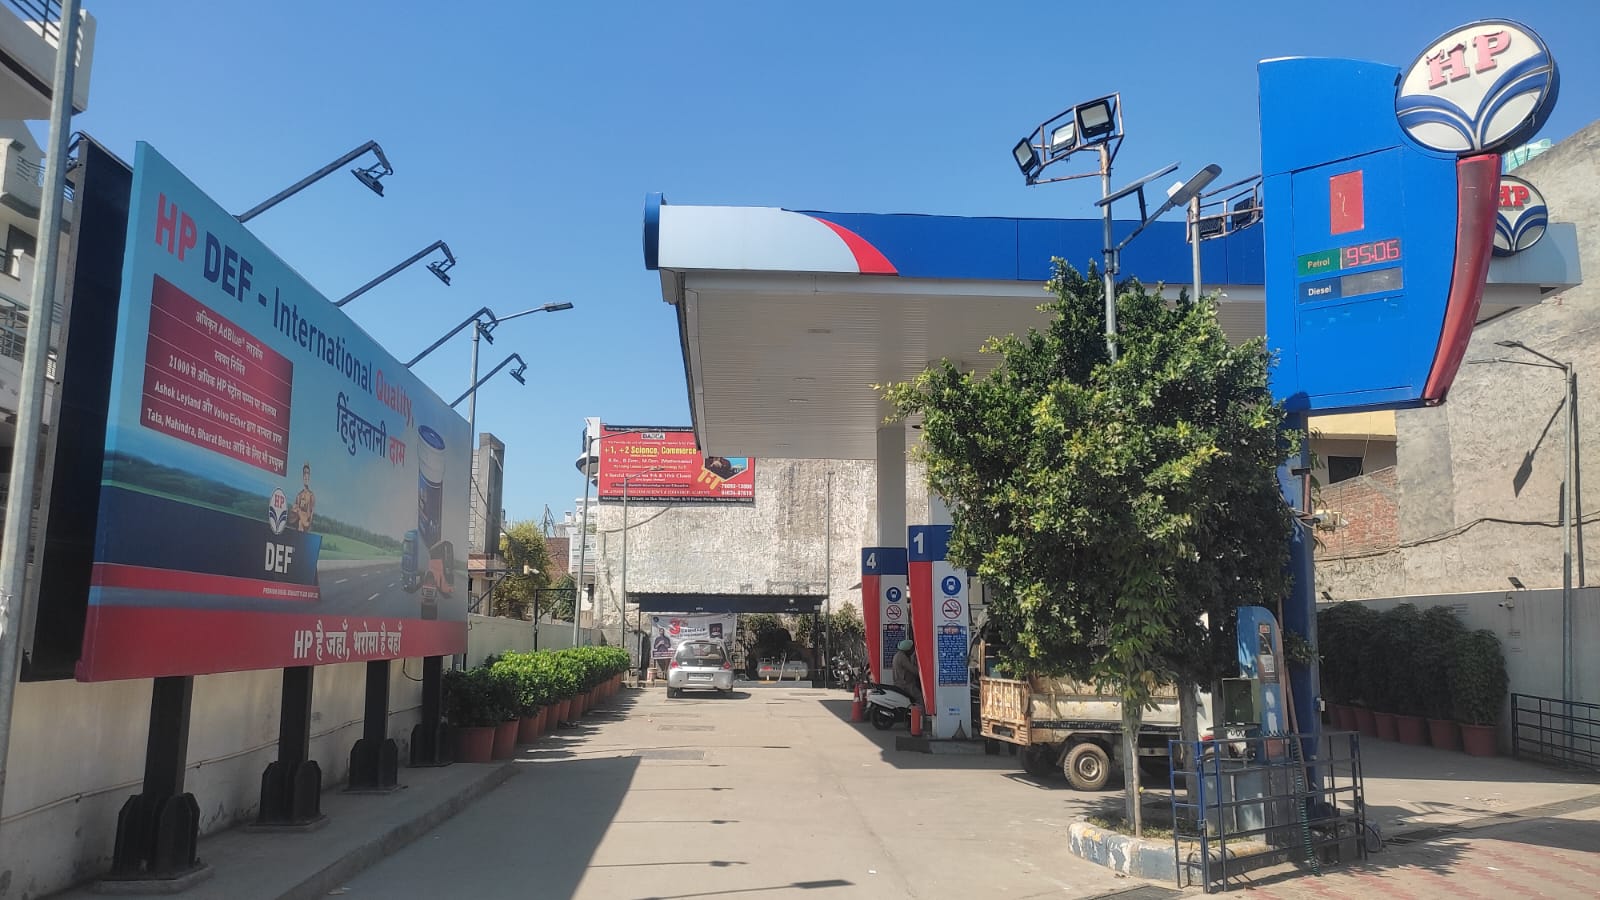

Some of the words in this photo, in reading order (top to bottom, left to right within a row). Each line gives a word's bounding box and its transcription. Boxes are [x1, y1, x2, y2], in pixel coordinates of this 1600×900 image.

[1426, 30, 1512, 90] HP
[1307, 257, 1330, 270] Petrol
[1346, 240, 1400, 267] 95.06
[155, 192, 197, 262] HP
[203, 230, 254, 303] DEF
[273, 286, 372, 395] International
[1308, 285, 1332, 297] Diesel
[169, 354, 189, 375] 21000
[217, 376, 226, 392] HP
[155, 380, 175, 399] Ashok
[177, 389, 200, 411] Leyland
[214, 407, 229, 421] Volvo
[147, 408, 164, 425] Tata,
[165, 414, 196, 437] Mahindra,
[198, 428, 217, 443] Bharat
[219, 436, 231, 449] Benz
[336, 391, 387, 458] हिंदुस्तानी
[389, 433, 406, 468] दाम
[661, 446, 697, 455] Commerce
[274, 493, 285, 509] HP
[264, 542, 293, 574] DEF
[866, 552, 877, 569] 4
[913, 532, 924, 554] 1
[294, 629, 313, 660] HP
[316, 619, 324, 661] है
[353, 622, 378, 656] भरोसा
[380, 621, 387, 655] है
